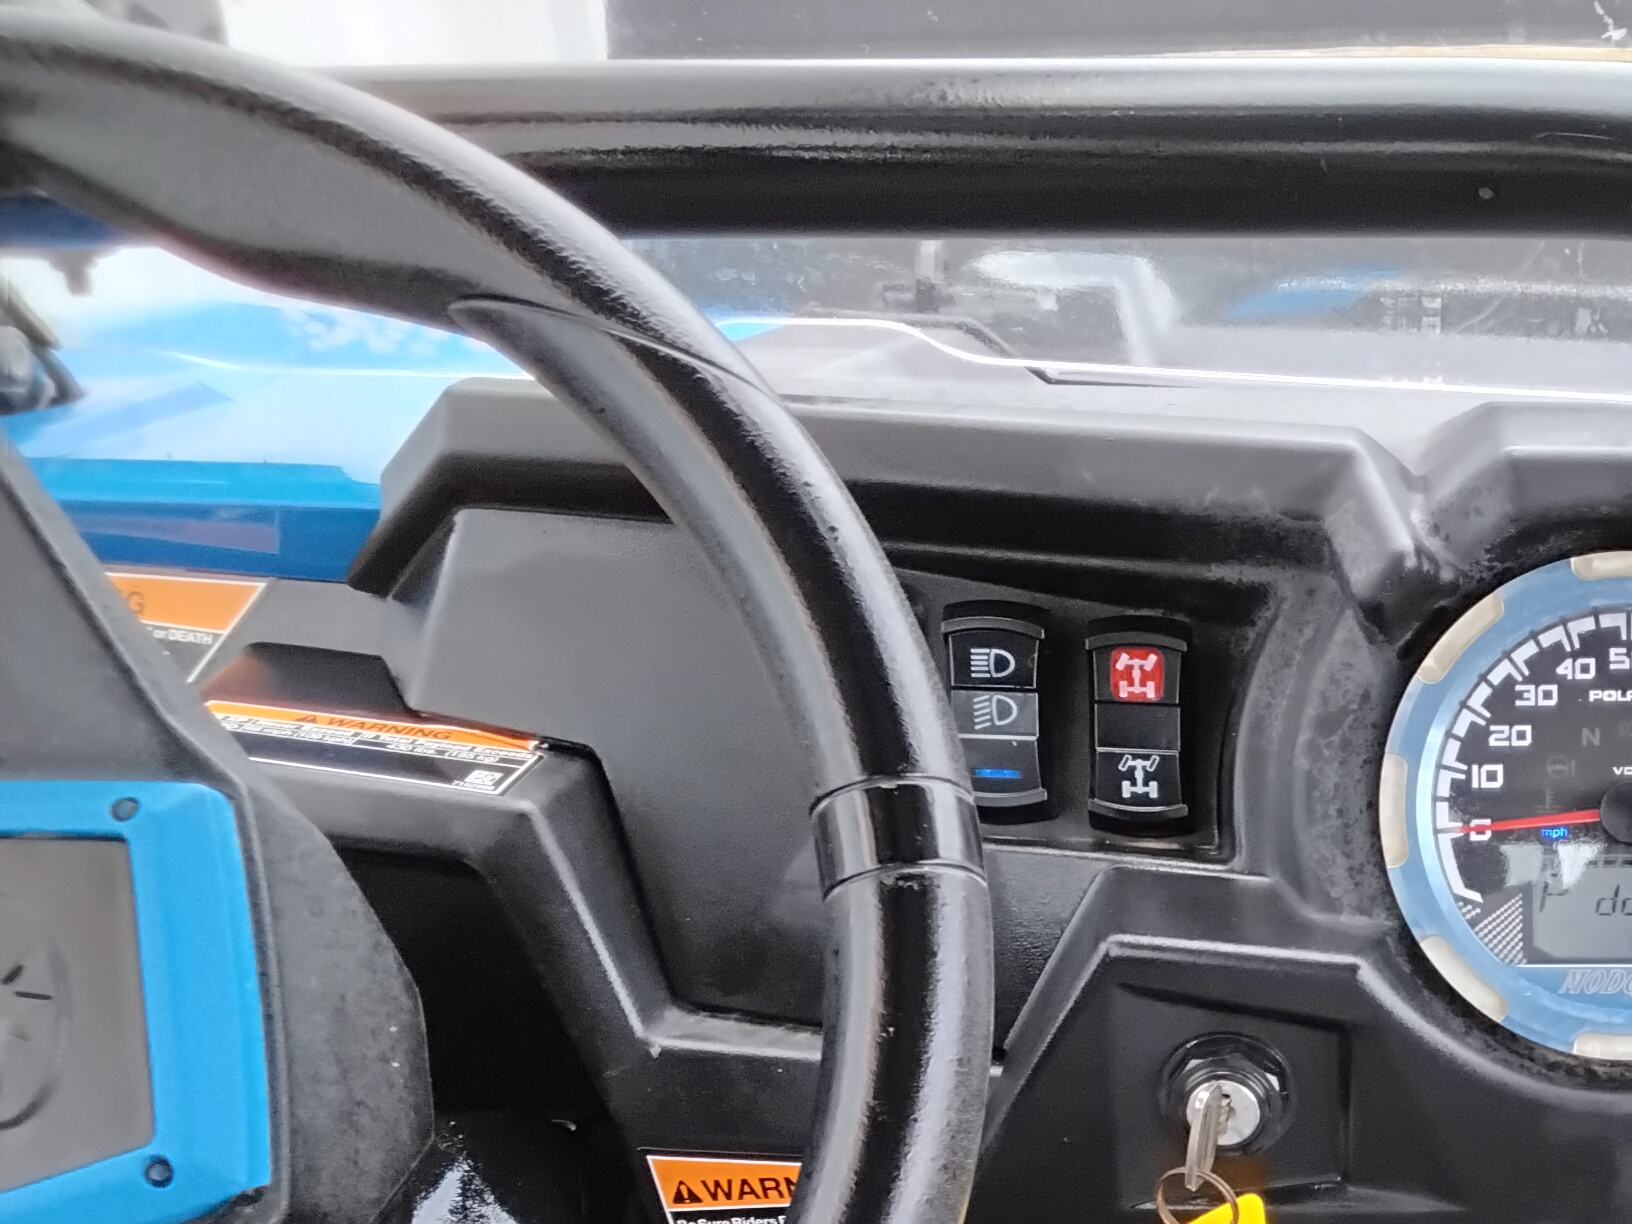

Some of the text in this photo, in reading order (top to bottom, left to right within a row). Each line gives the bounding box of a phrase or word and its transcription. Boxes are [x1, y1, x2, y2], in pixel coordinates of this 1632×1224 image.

[167, 629, 215, 645] DEATH
[1555, 657, 1596, 680] 40
[1514, 684, 1558, 707] 30
[327, 717, 453, 740] WARNING
[1488, 724, 1532, 747] 20
[378, 734, 409, 746] Total
[419, 738, 472, 752] Payload
[473, 746, 533, 760] Exceeds
[1471, 763, 1504, 789] 10
[1541, 827, 1569, 839] mph
